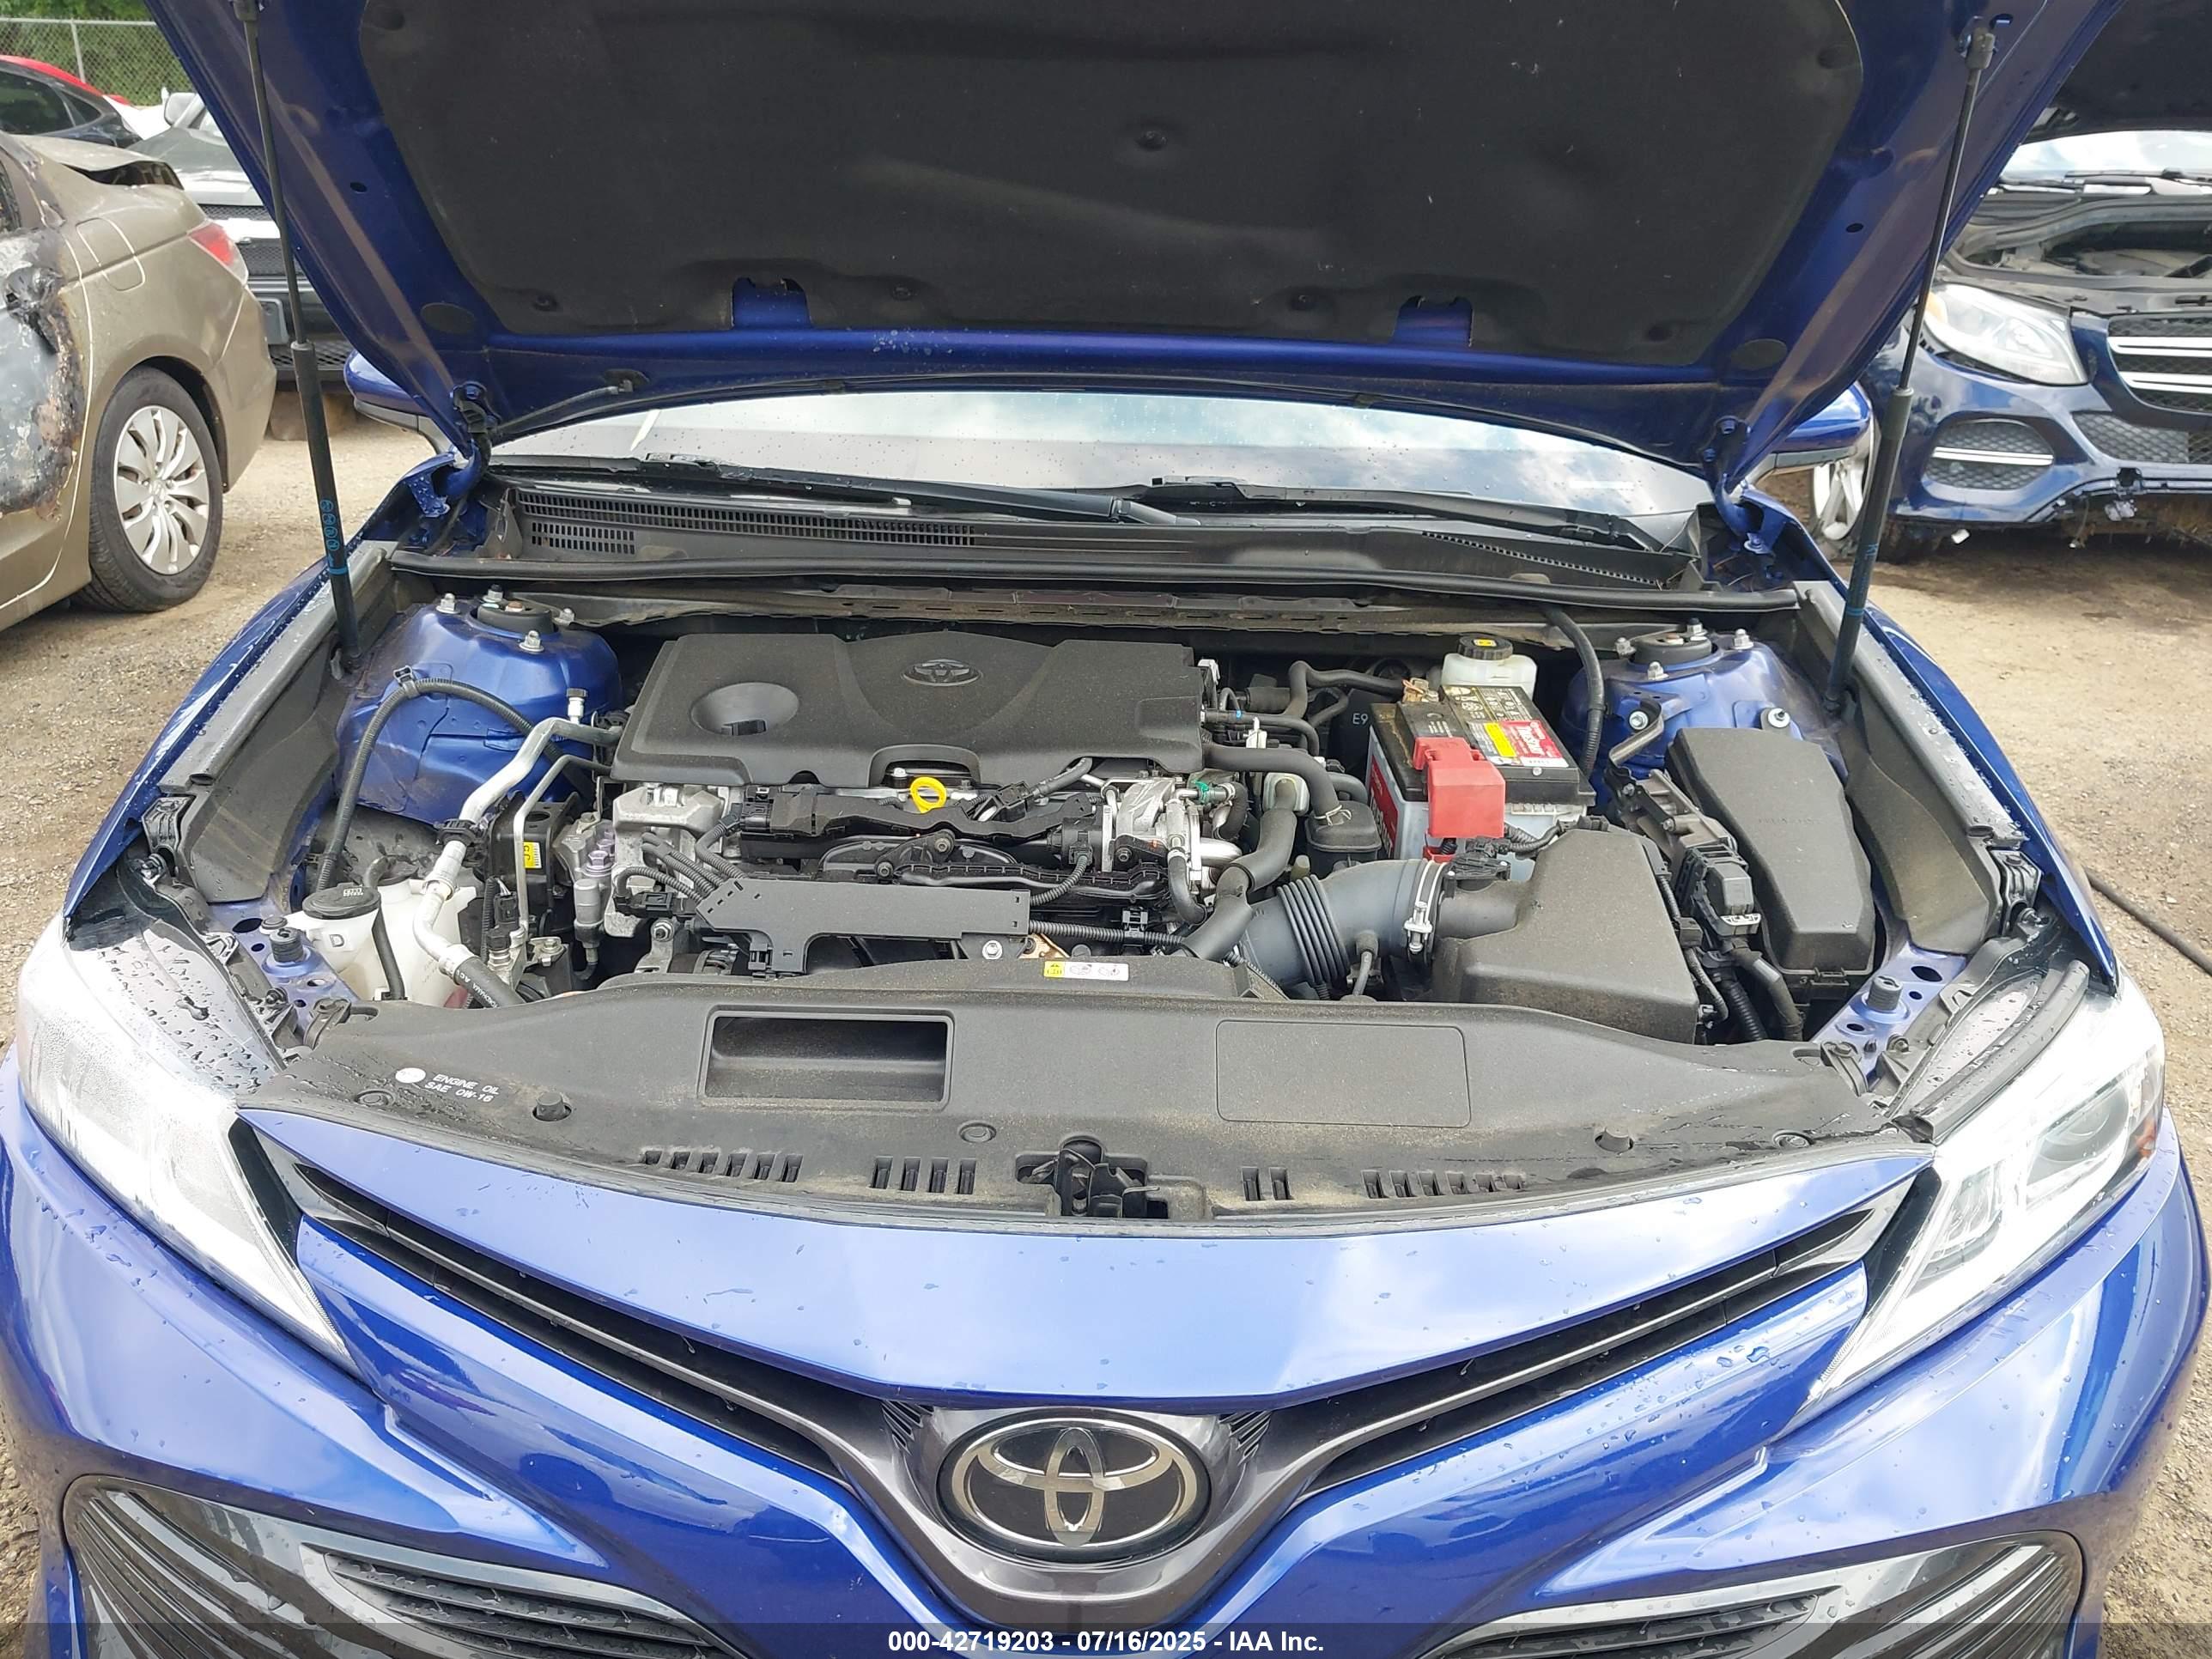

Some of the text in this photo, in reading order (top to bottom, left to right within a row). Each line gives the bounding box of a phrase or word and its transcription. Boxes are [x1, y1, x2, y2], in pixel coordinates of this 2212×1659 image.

[1352, 713, 1368, 725] E9
[424, 1081, 494, 1103] SAE 0W-16
[433, 1073, 500, 1095] ENGINE OIL
